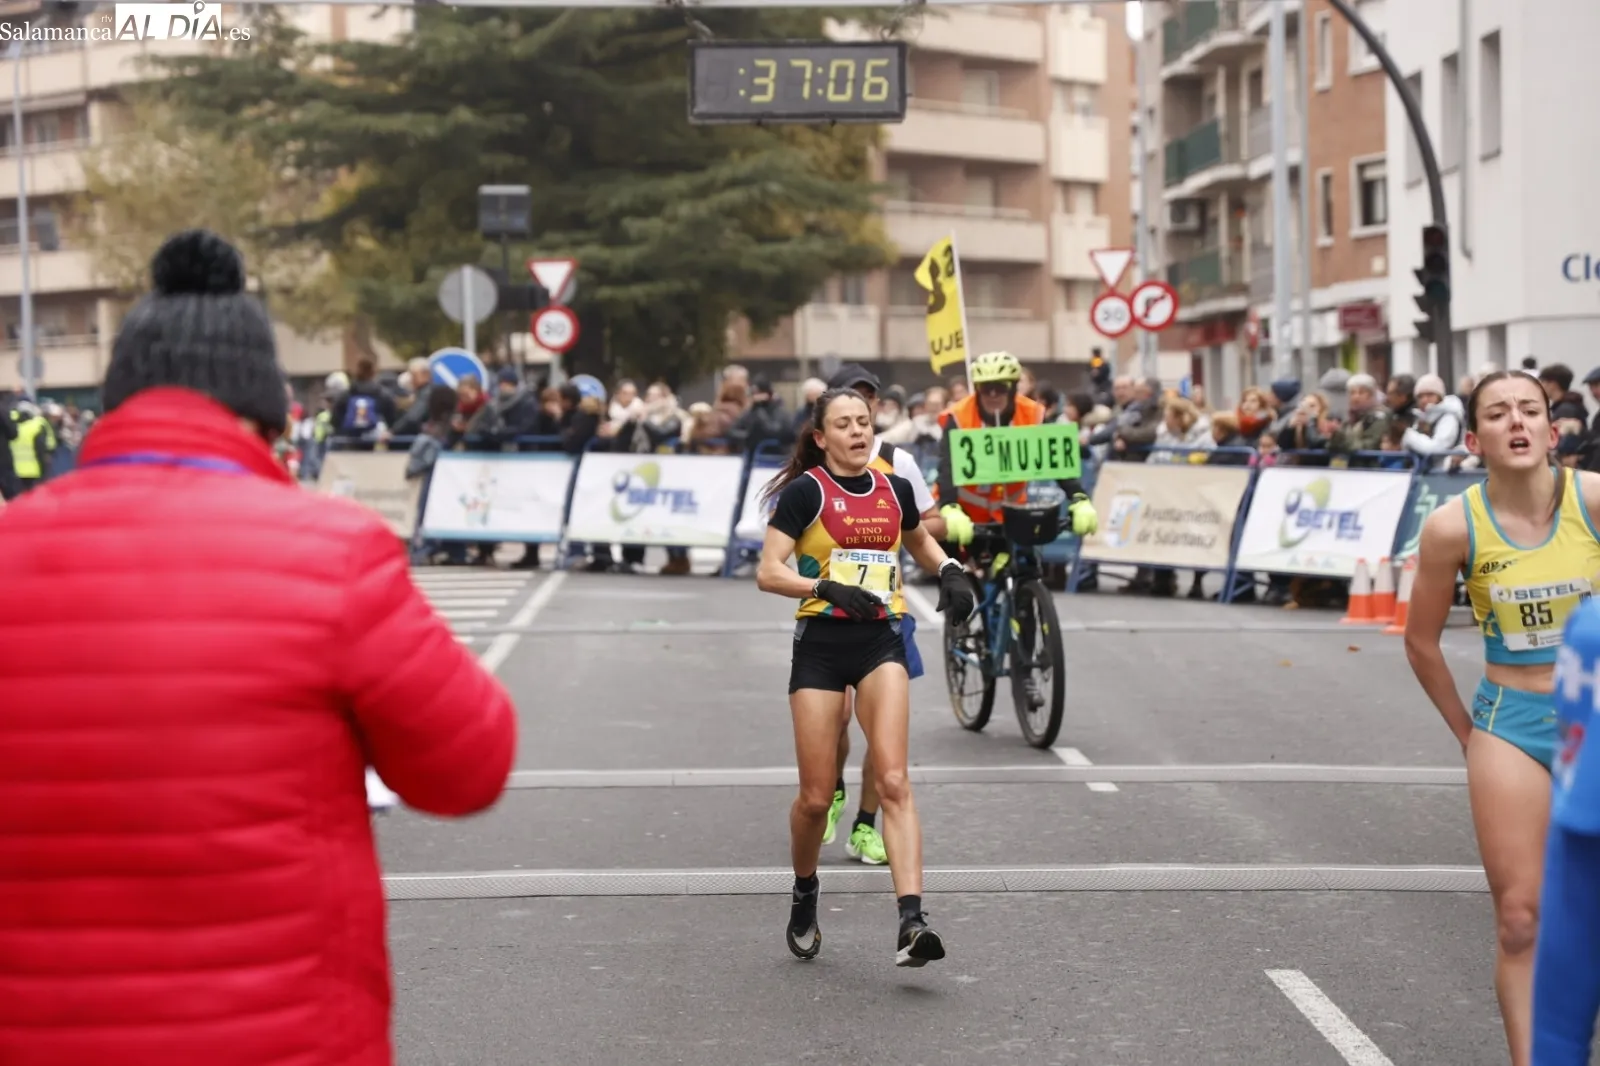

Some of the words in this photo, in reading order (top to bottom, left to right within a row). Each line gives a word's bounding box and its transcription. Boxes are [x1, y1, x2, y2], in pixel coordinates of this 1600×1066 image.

[930, 330, 963, 355] UJE
[998, 436, 1075, 472] MUJER
[845, 536, 860, 544] DE
[862, 535, 891, 543] TORO
[854, 526, 882, 535] VINO
[850, 552, 892, 563] SETEL
[858, 564, 868, 585] 7
[1514, 582, 1581, 601] SETEL
[1519, 601, 1553, 627] 85
